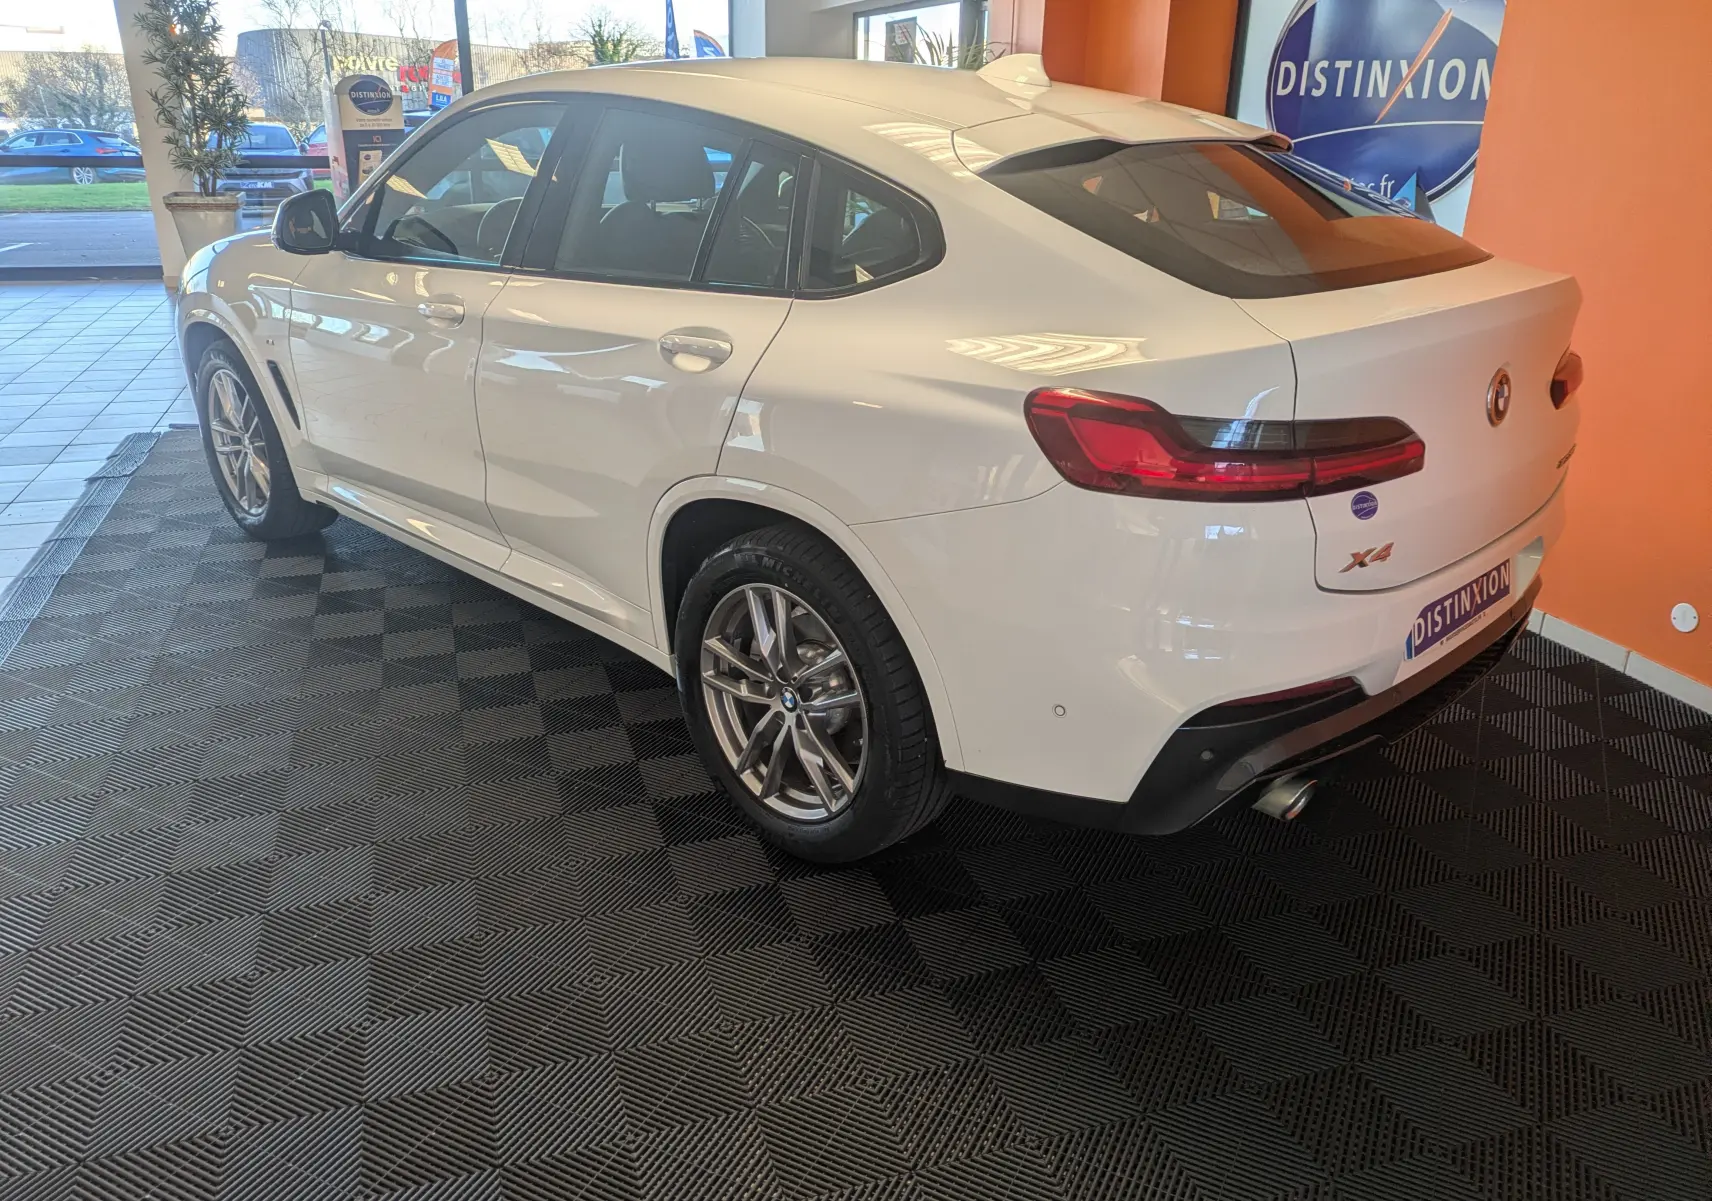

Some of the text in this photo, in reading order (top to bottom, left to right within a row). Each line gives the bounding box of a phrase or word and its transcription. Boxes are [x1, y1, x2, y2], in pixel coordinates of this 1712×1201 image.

[350, 91, 392, 99] DISTINXION
[1276, 58, 1492, 100] DISTINXION
[1338, 542, 1394, 573] X4
[1413, 562, 1510, 647] DISTINXION
